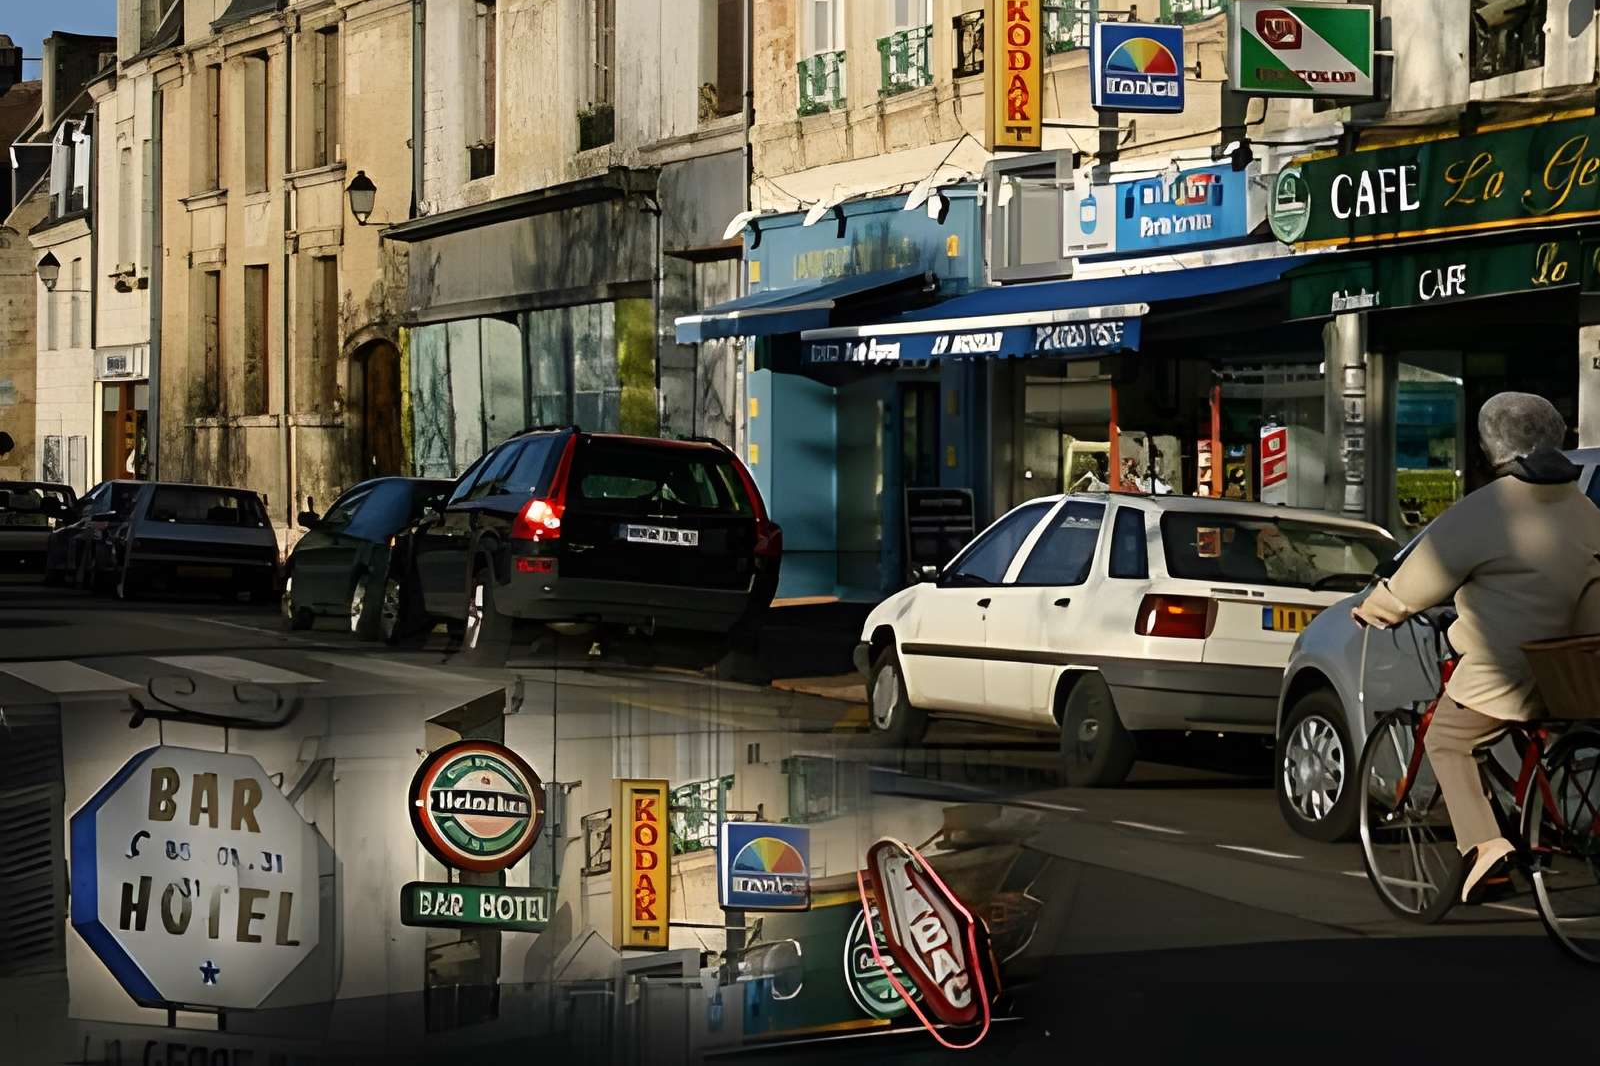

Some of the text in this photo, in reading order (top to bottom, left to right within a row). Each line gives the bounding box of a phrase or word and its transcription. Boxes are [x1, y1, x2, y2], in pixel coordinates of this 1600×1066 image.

[1330, 164, 1420, 219] CAFE
[1444, 152, 1504, 207] La
[1419, 263, 1467, 302] CAFE
[148, 766, 262, 833] BAR
[119, 876, 300, 947] HOTEL
